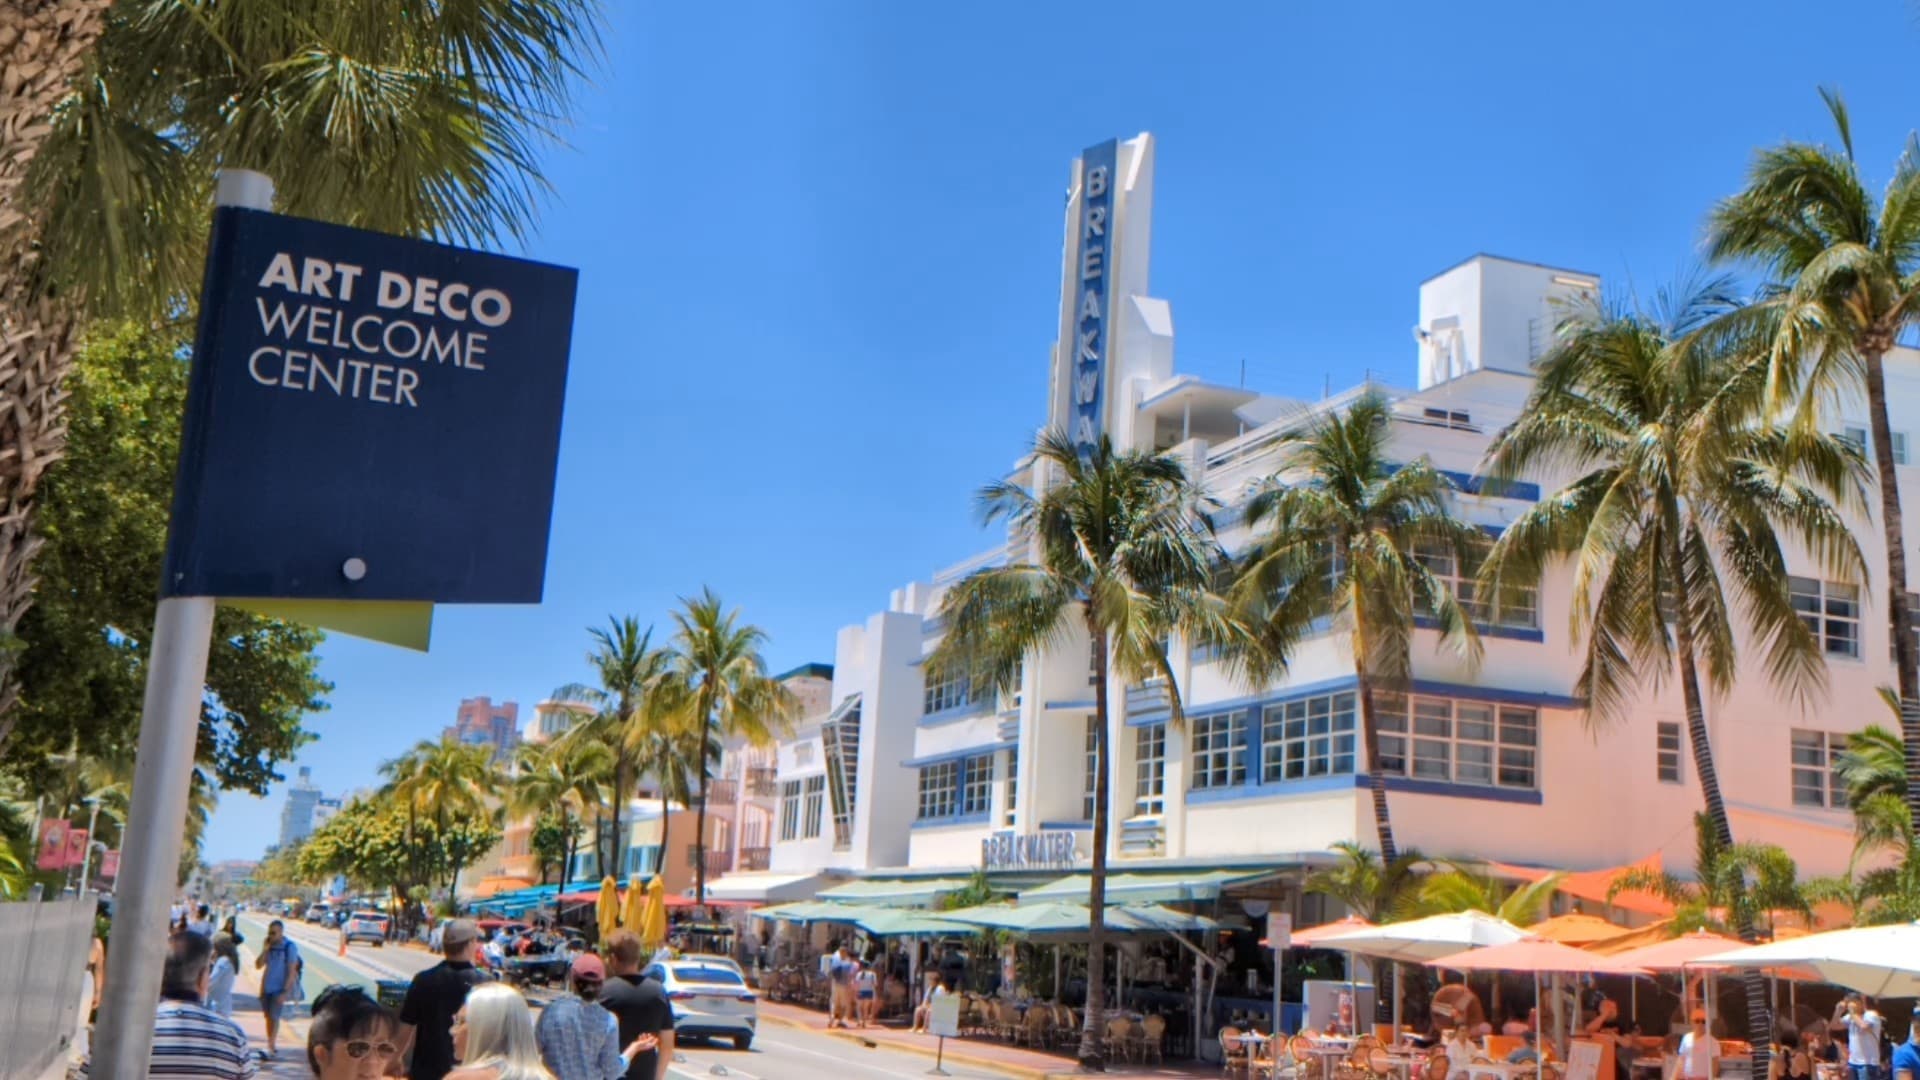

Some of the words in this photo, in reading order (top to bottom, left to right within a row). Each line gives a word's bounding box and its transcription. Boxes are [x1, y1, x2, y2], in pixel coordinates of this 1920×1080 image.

[258, 252, 363, 302] ART
[376, 270, 512, 328] DECO
[256, 297, 488, 371] WELCOME
[248, 346, 420, 407] CENTER
[981, 832, 1076, 865] BREAKWATER
